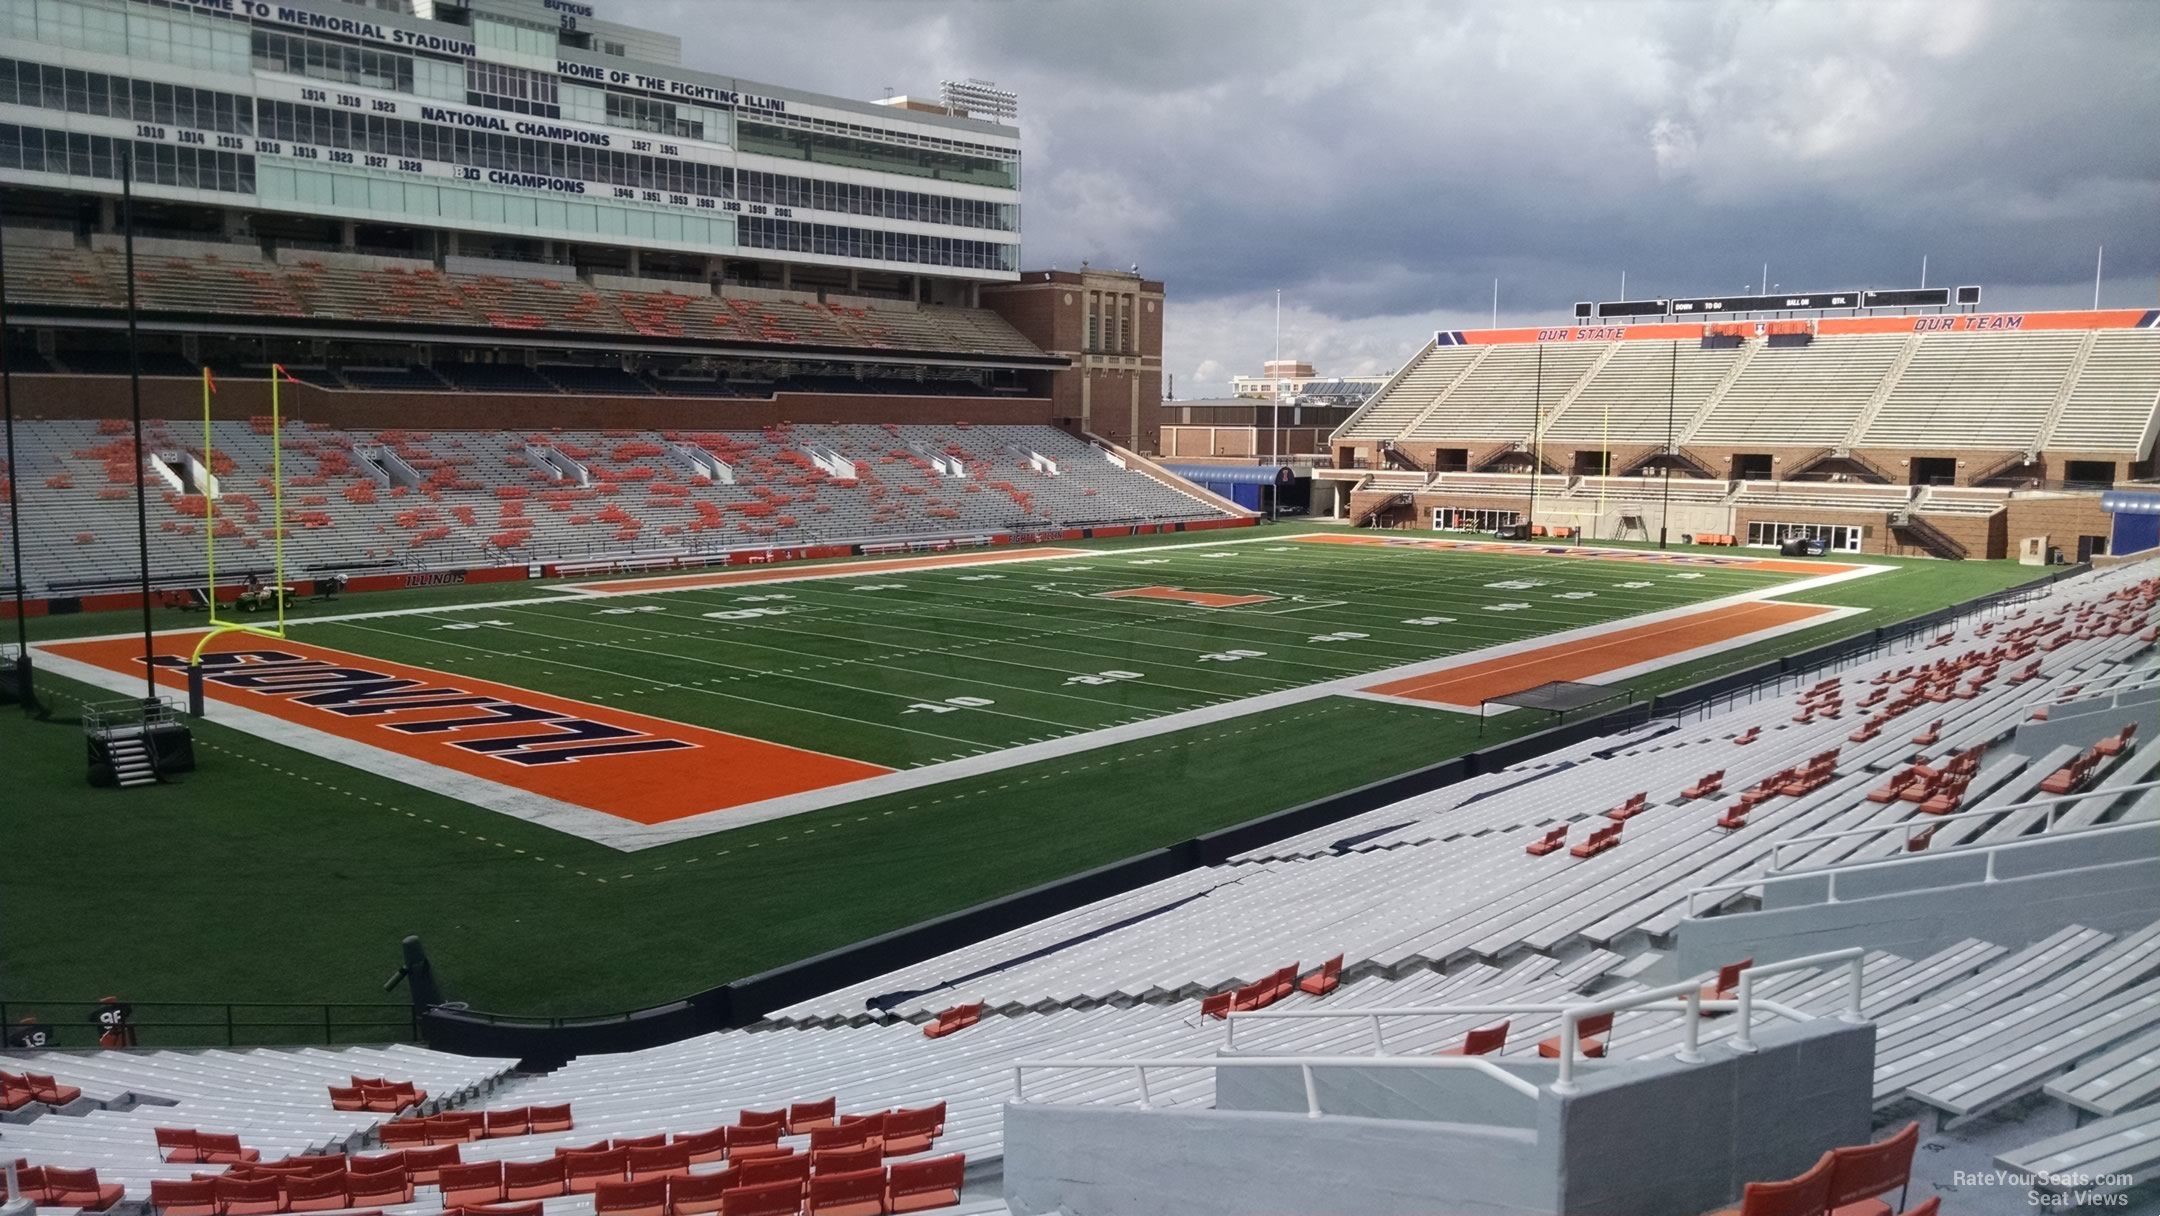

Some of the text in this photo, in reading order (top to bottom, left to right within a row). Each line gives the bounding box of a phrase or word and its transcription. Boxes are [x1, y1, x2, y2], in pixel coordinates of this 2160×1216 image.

[544, 0, 592, 16] BUTKUS
[242, 0, 476, 56] TO MEMORIAL STADIUM
[561, 15, 576, 29] 50
[557, 61, 785, 111] HOME OF THE FIGHTING ILLINI
[301, 88, 678, 155] 1914 1919 1923 NATIONAL CHAMPIONS 1927 1951
[178, 130, 205, 144] 1914
[217, 136, 243, 149] 1915
[364, 155, 388, 168] 1927
[399, 160, 422, 172] 1928
[488, 171, 585, 194] CHAMPIONS
[613, 187, 634, 199] 1946
[642, 191, 661, 202] 1951
[1914, 317, 2022, 330] OUR TEAM
[1538, 328, 1625, 340] OUR STATE
[406, 573, 465, 587] ILLINOIS
[900, 696, 995, 714] 10
